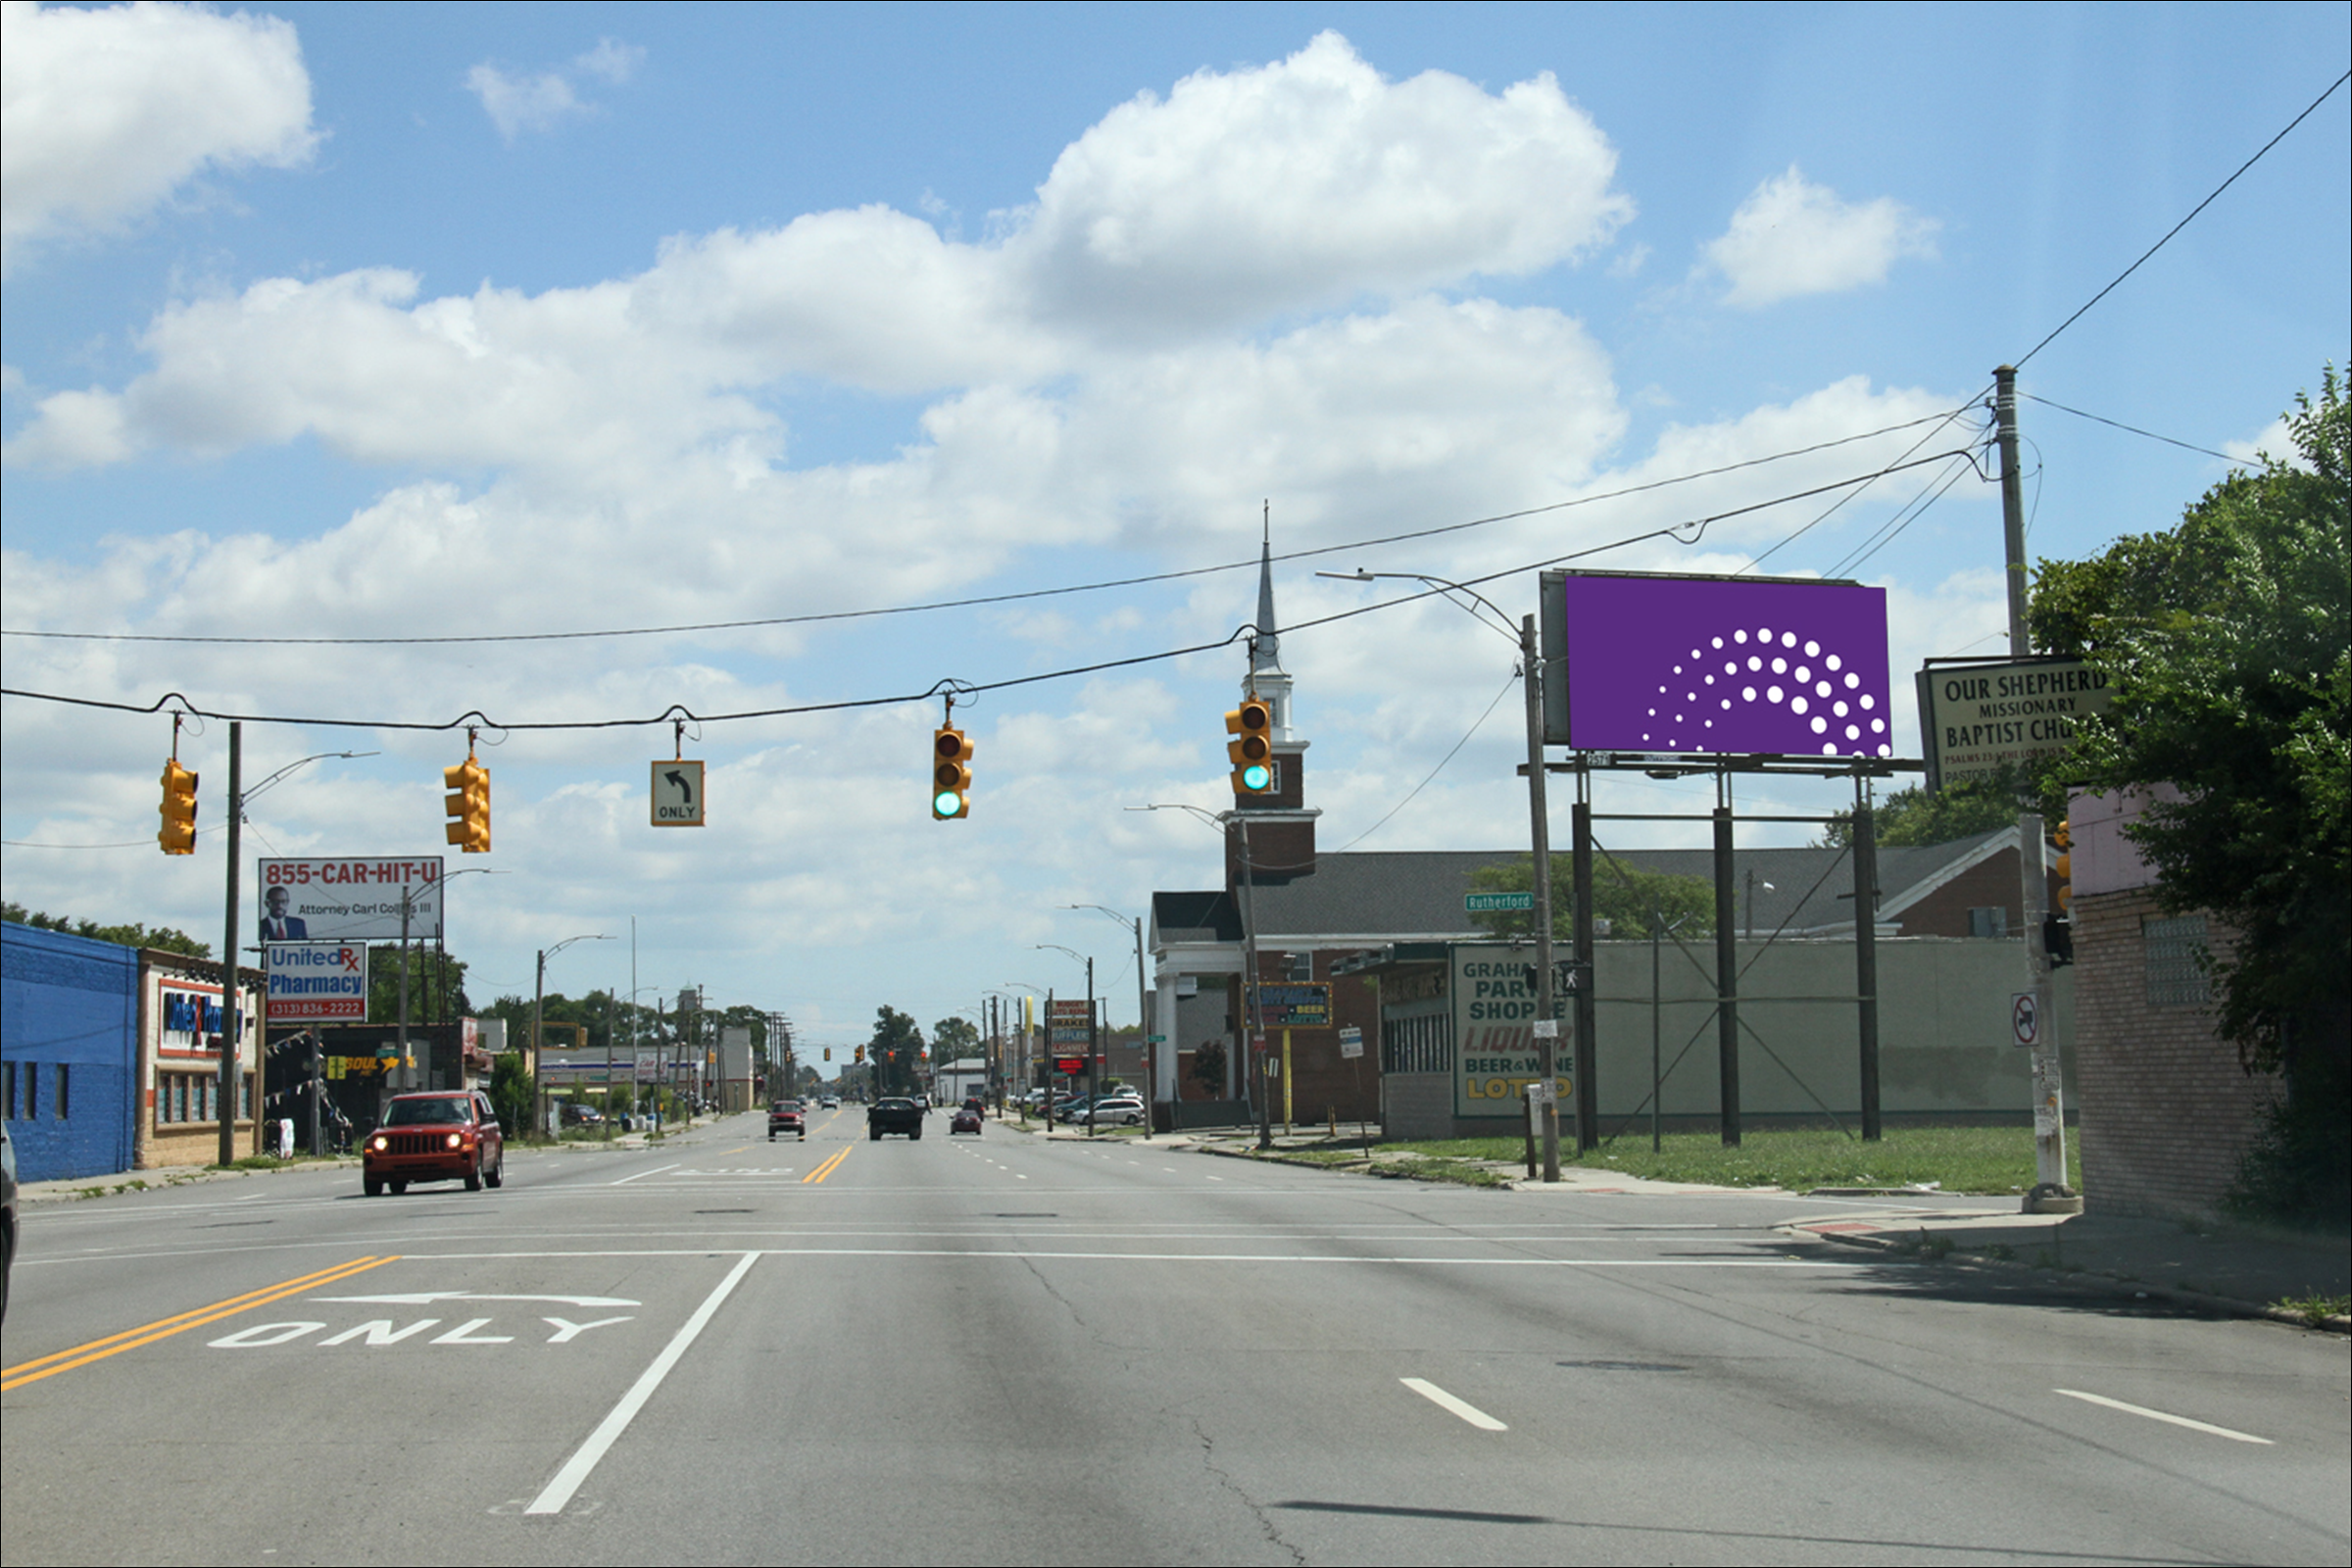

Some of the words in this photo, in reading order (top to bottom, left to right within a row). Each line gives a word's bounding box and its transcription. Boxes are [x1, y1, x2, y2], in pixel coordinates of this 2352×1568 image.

[1945, 678, 1990, 702] OUR
[1998, 669, 2106, 698] SHEPHERD
[1980, 698, 2076, 718] MISSIONARY
[1946, 721, 2024, 748] BAPTIST
[2031, 717, 2080, 741] CHU
[1945, 753, 1980, 765] PSALMS
[1945, 768, 1990, 782] PASTOR
[659, 806, 696, 818] ONLY
[267, 862, 437, 885] 855-CAR-HIT-U
[298, 904, 350, 916] Attorney
[352, 903, 377, 914] Carl
[379, 903, 417, 914] Colls
[1470, 897, 1530, 908] Rutherford
[1463, 962, 1565, 978] GRAHA
[270, 974, 363, 995] Pharmacy
[1476, 981, 1538, 998] PAR
[1297, 1004, 1325, 1013] BEER
[1469, 1002, 1565, 1019] SHOPE
[207, 1316, 636, 1348] ONLY
